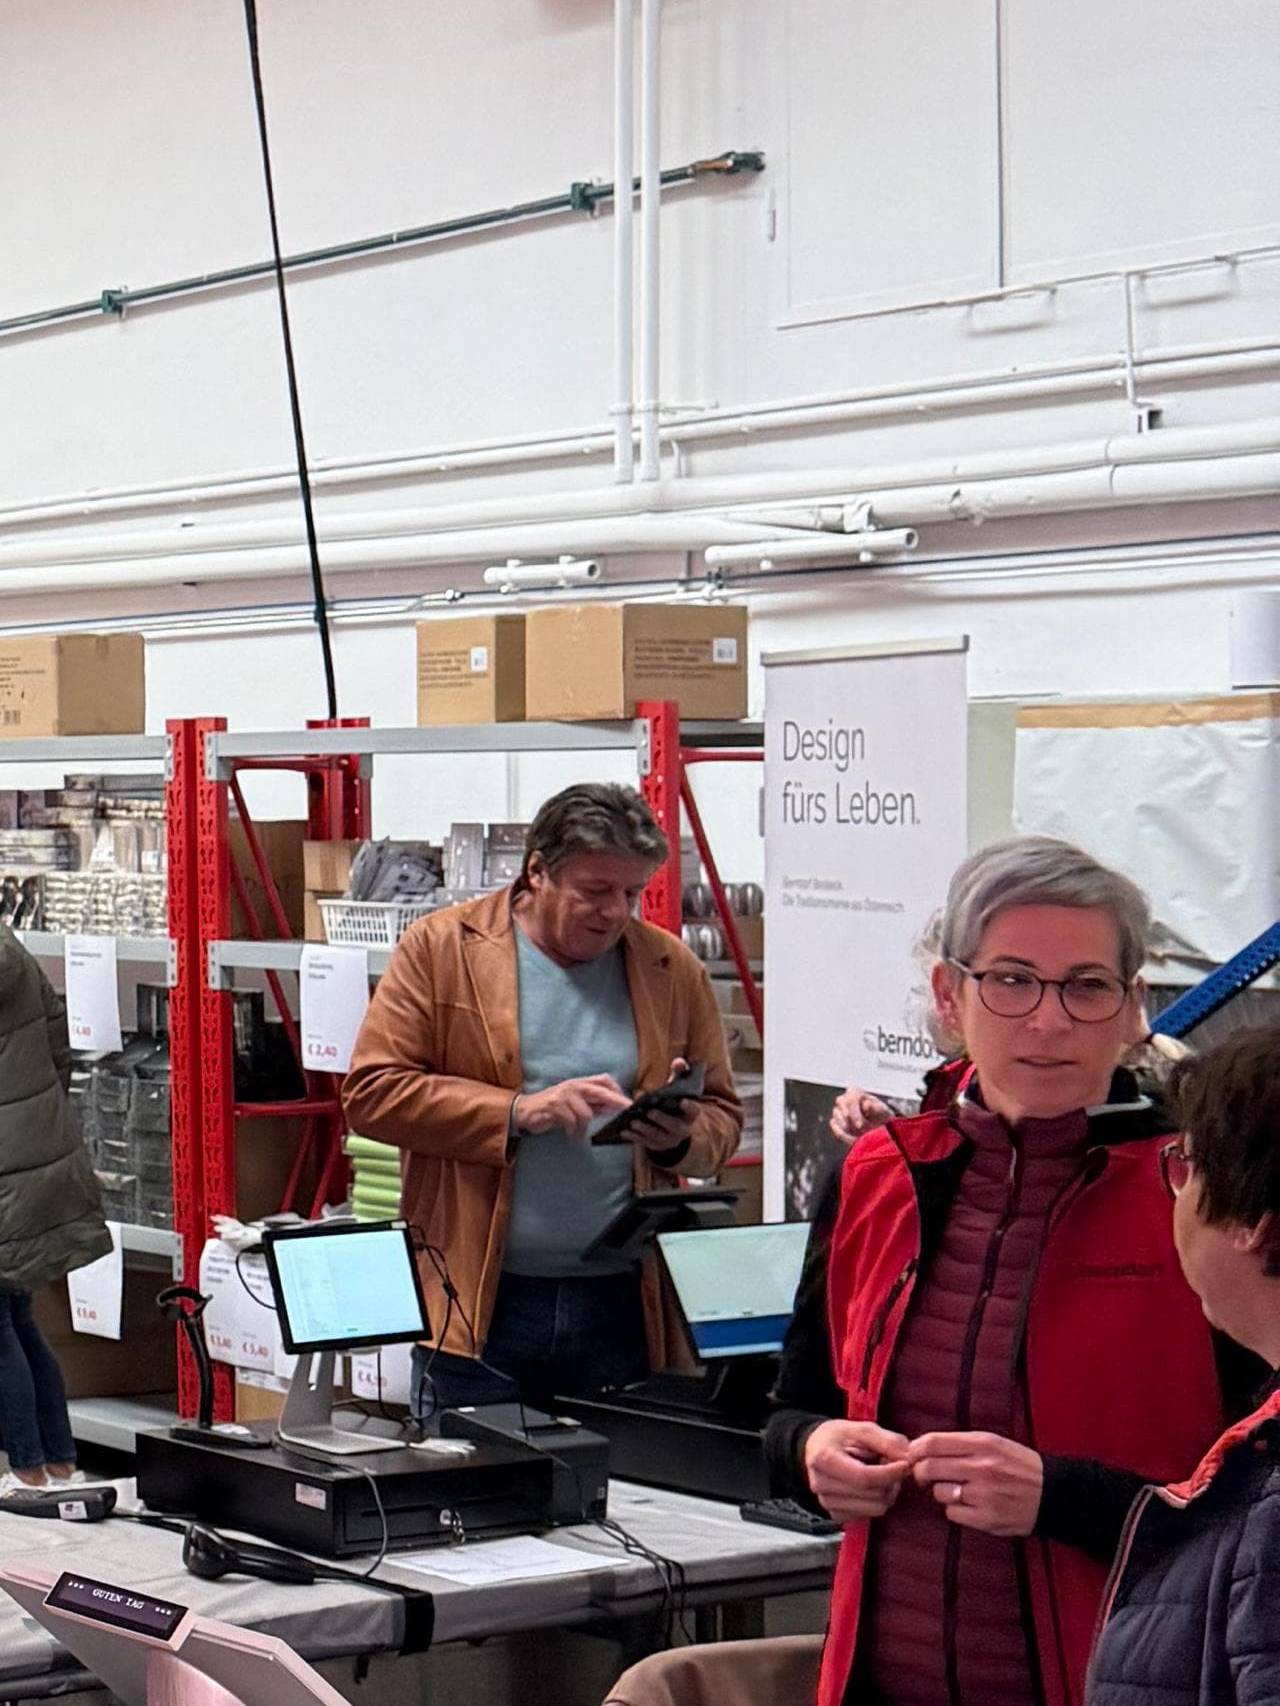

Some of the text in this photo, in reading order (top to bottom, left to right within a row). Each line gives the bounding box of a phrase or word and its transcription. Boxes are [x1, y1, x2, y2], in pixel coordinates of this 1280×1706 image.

[783, 718, 865, 773] Design
[783, 780, 921, 826] fürs Leben.
[92, 1588, 145, 1610] GUTEN TAG
